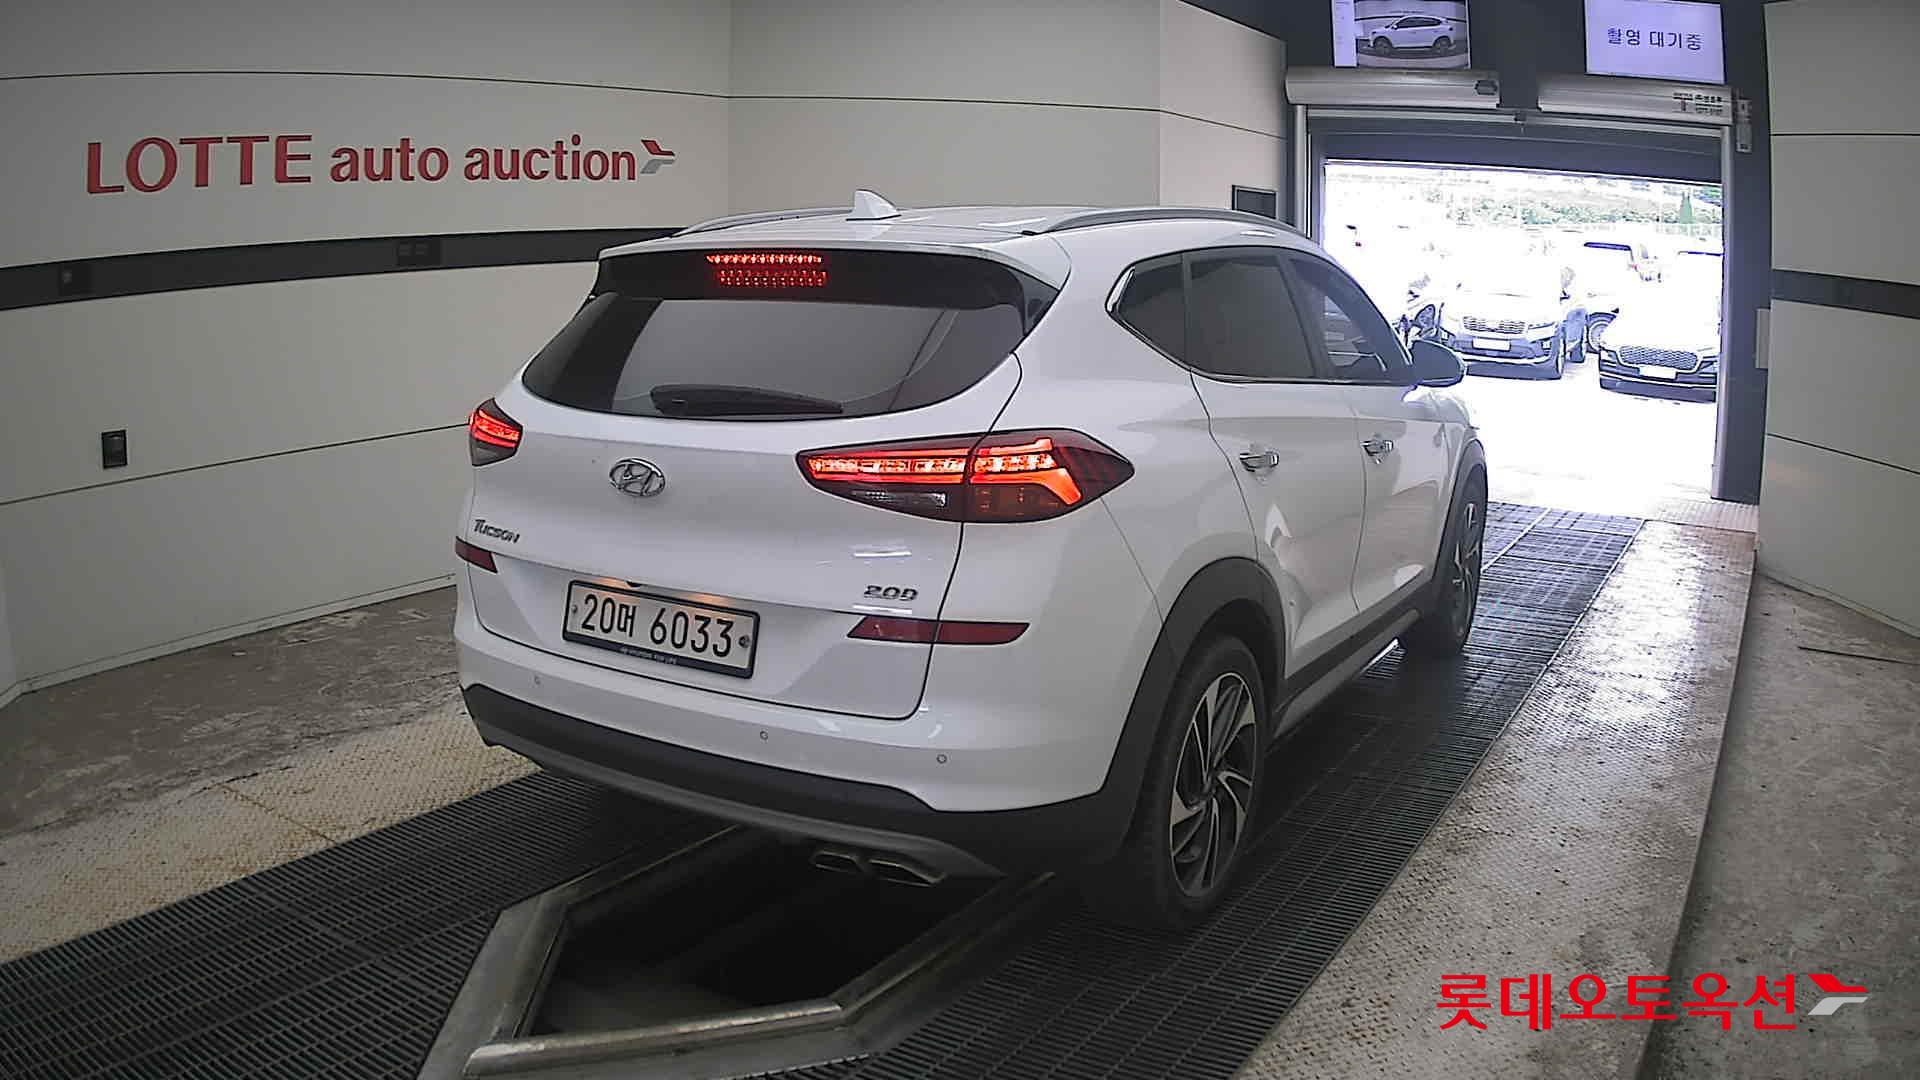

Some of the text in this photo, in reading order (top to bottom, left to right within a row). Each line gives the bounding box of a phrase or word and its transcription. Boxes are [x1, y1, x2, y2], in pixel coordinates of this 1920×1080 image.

[1649, 31, 1702, 51] 대기중
[86, 134, 637, 194] LOTTE auto auction
[581, 593, 734, 658] 20머 6033
